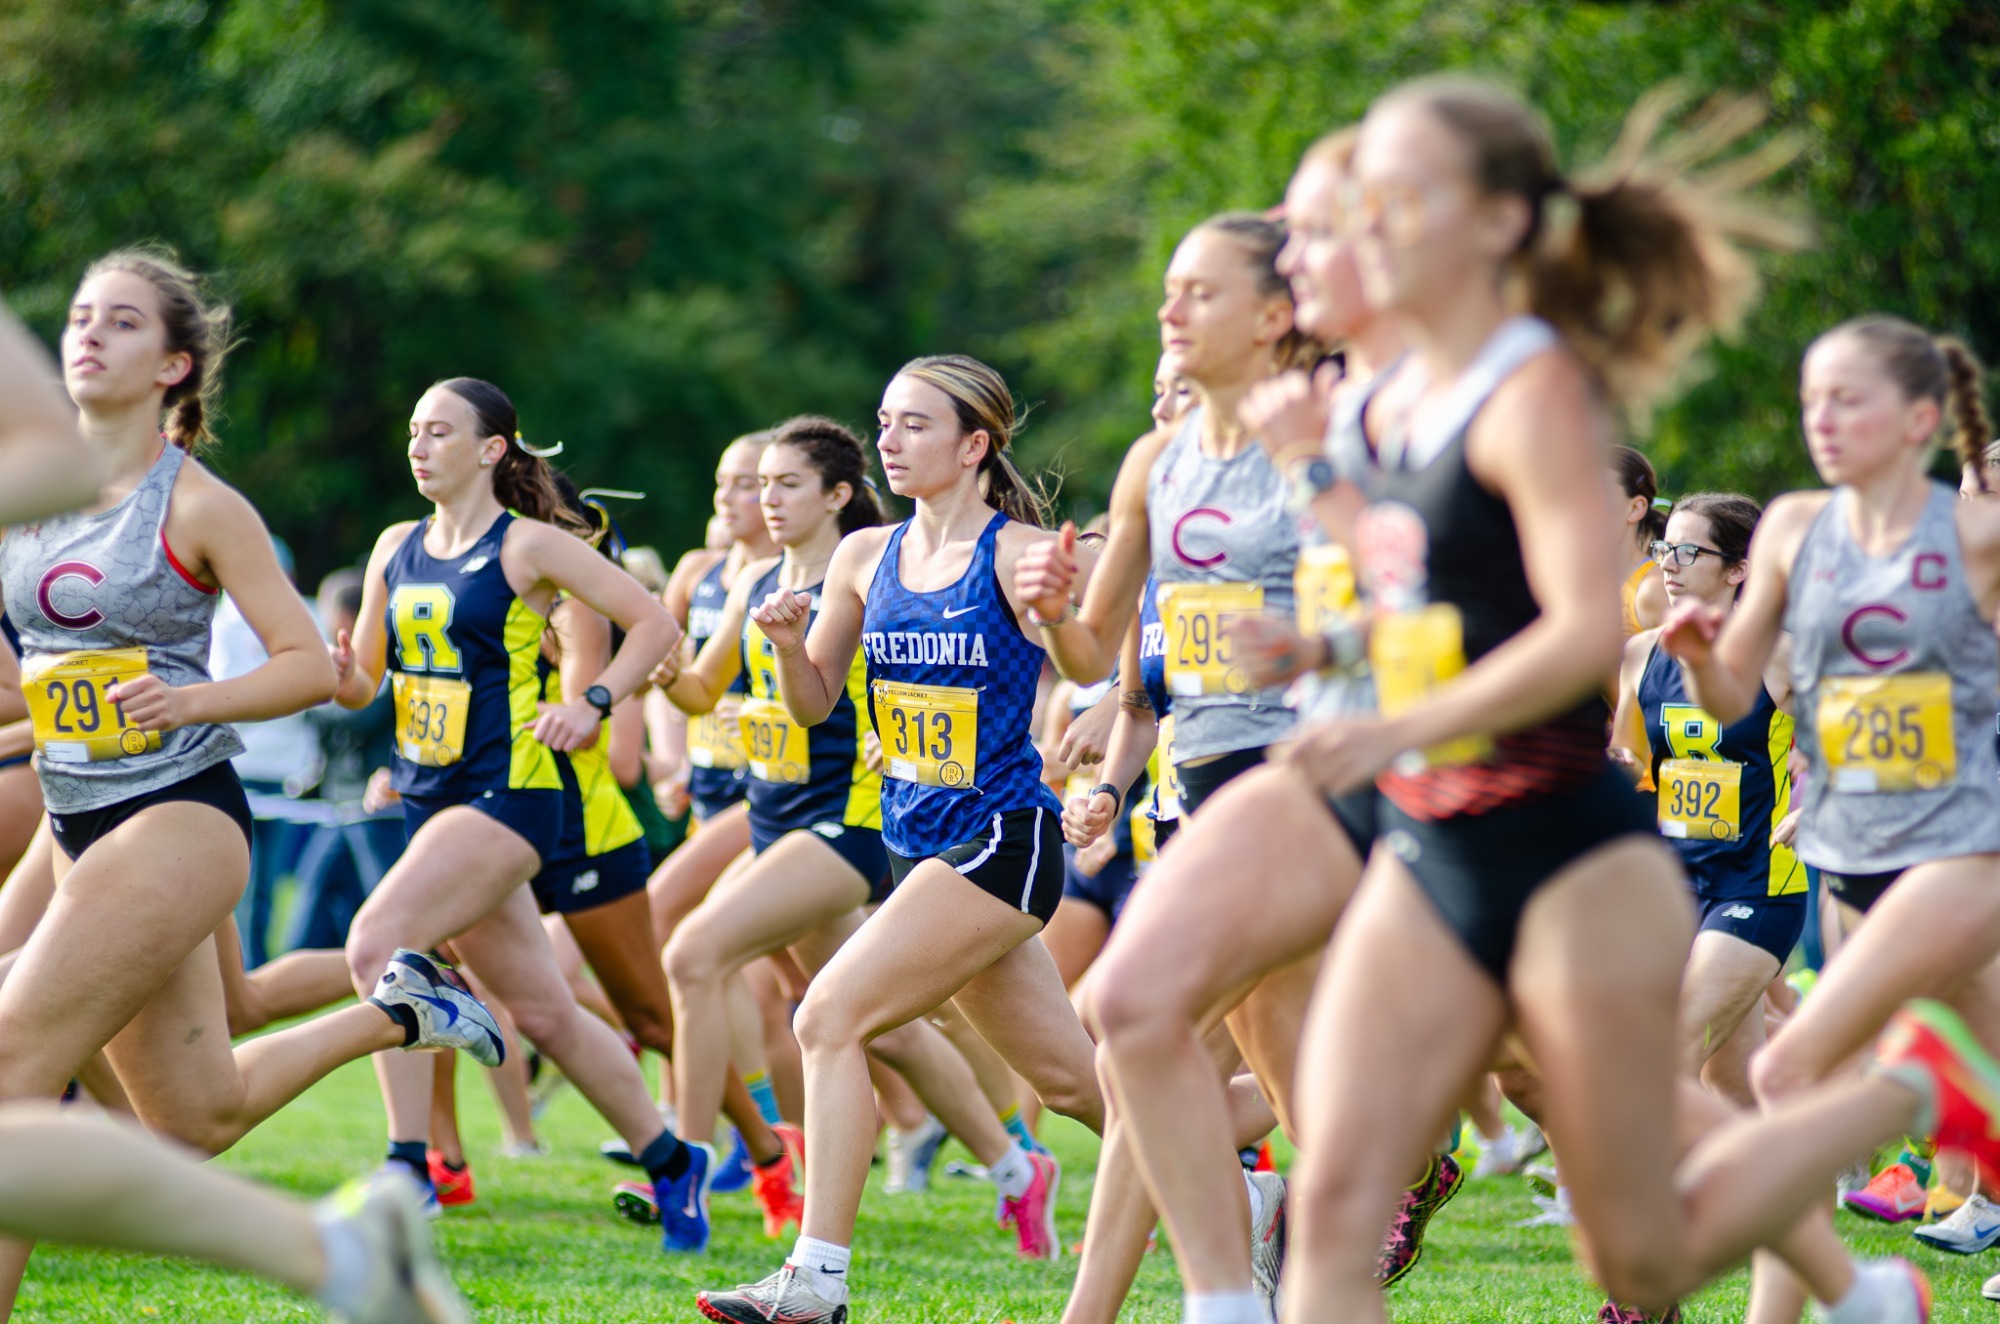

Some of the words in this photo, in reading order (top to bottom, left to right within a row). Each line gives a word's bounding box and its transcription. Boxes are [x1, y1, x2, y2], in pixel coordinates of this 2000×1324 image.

[1171, 506, 1233, 571] C
[36, 560, 107, 632] C
[1911, 552, 1947, 590] C
[389, 583, 463, 673] R
[863, 632, 989, 667] FREDONIA
[1140, 622, 1168, 659] FR
[1177, 613, 1239, 666] 295
[1841, 602, 1911, 670] C
[46, 676, 126, 733] 291
[407, 698, 447, 741] 393
[748, 720, 788, 760] 397
[891, 708, 953, 761] 313
[1660, 703, 1732, 762] R
[1843, 704, 1924, 761] 285
[1671, 779, 1721, 819] 392
[1721, 904, 1754, 919] NB
